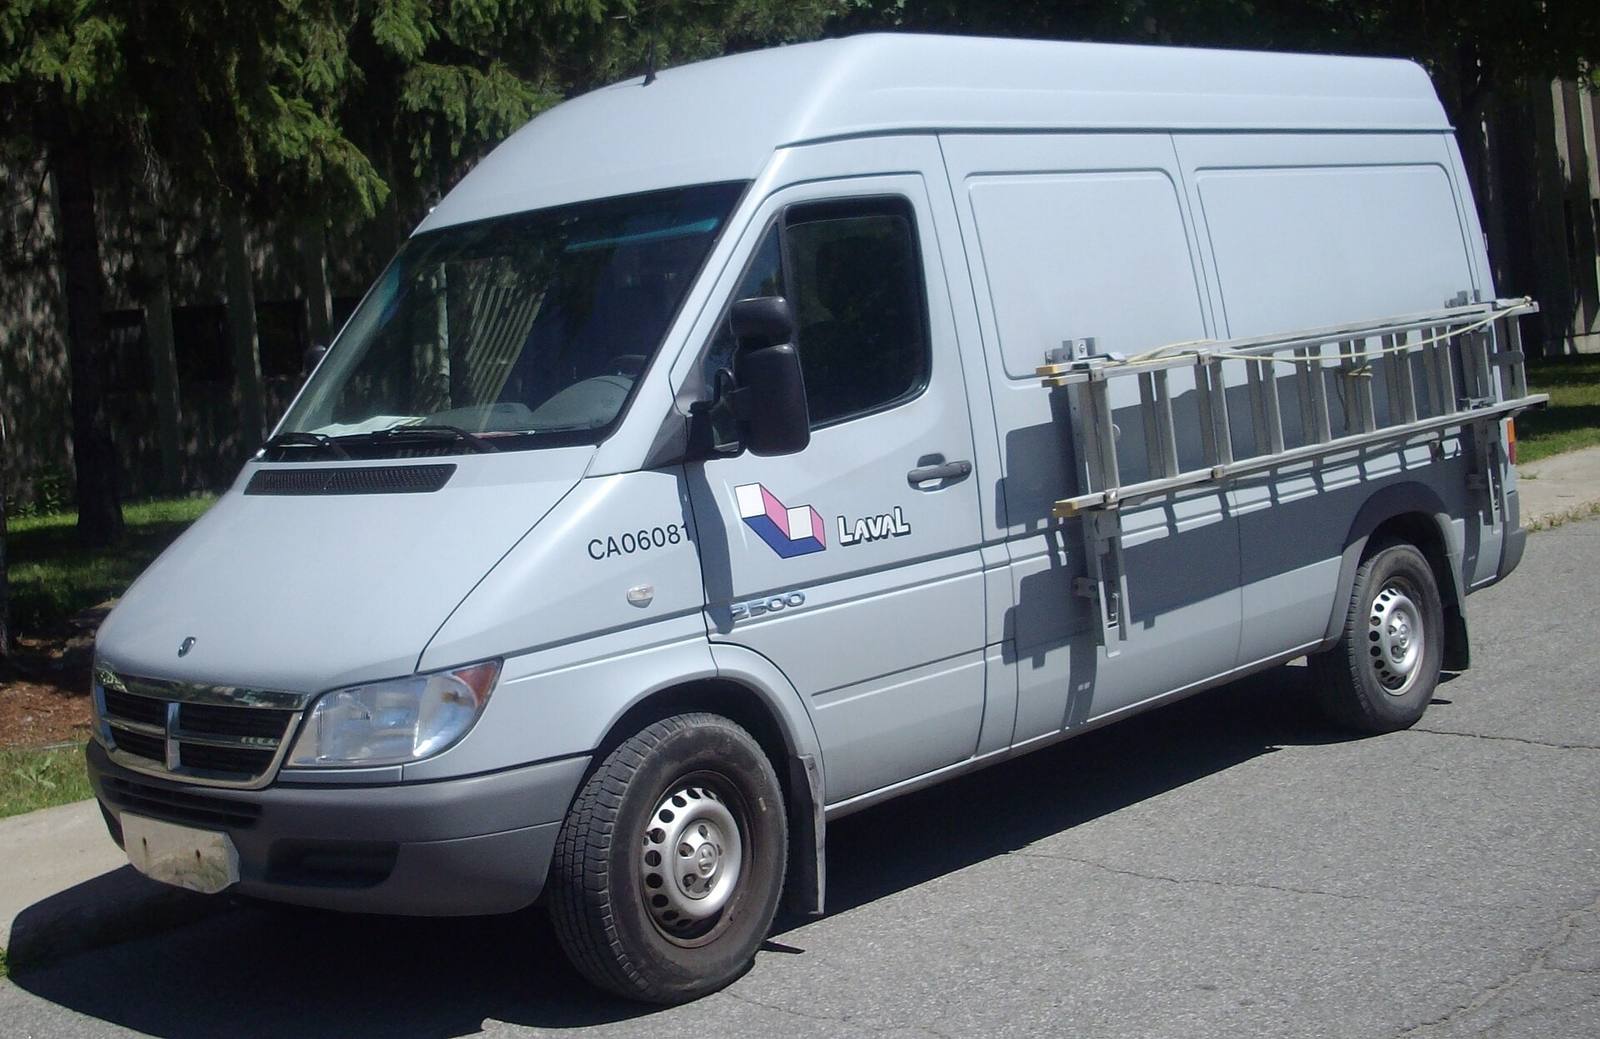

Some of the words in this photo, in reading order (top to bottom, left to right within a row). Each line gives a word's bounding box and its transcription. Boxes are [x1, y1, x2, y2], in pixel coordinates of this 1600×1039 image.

[587, 521, 691, 560] CA06081
[837, 506, 911, 547] LAVAL
[729, 591, 806, 621] 2500
